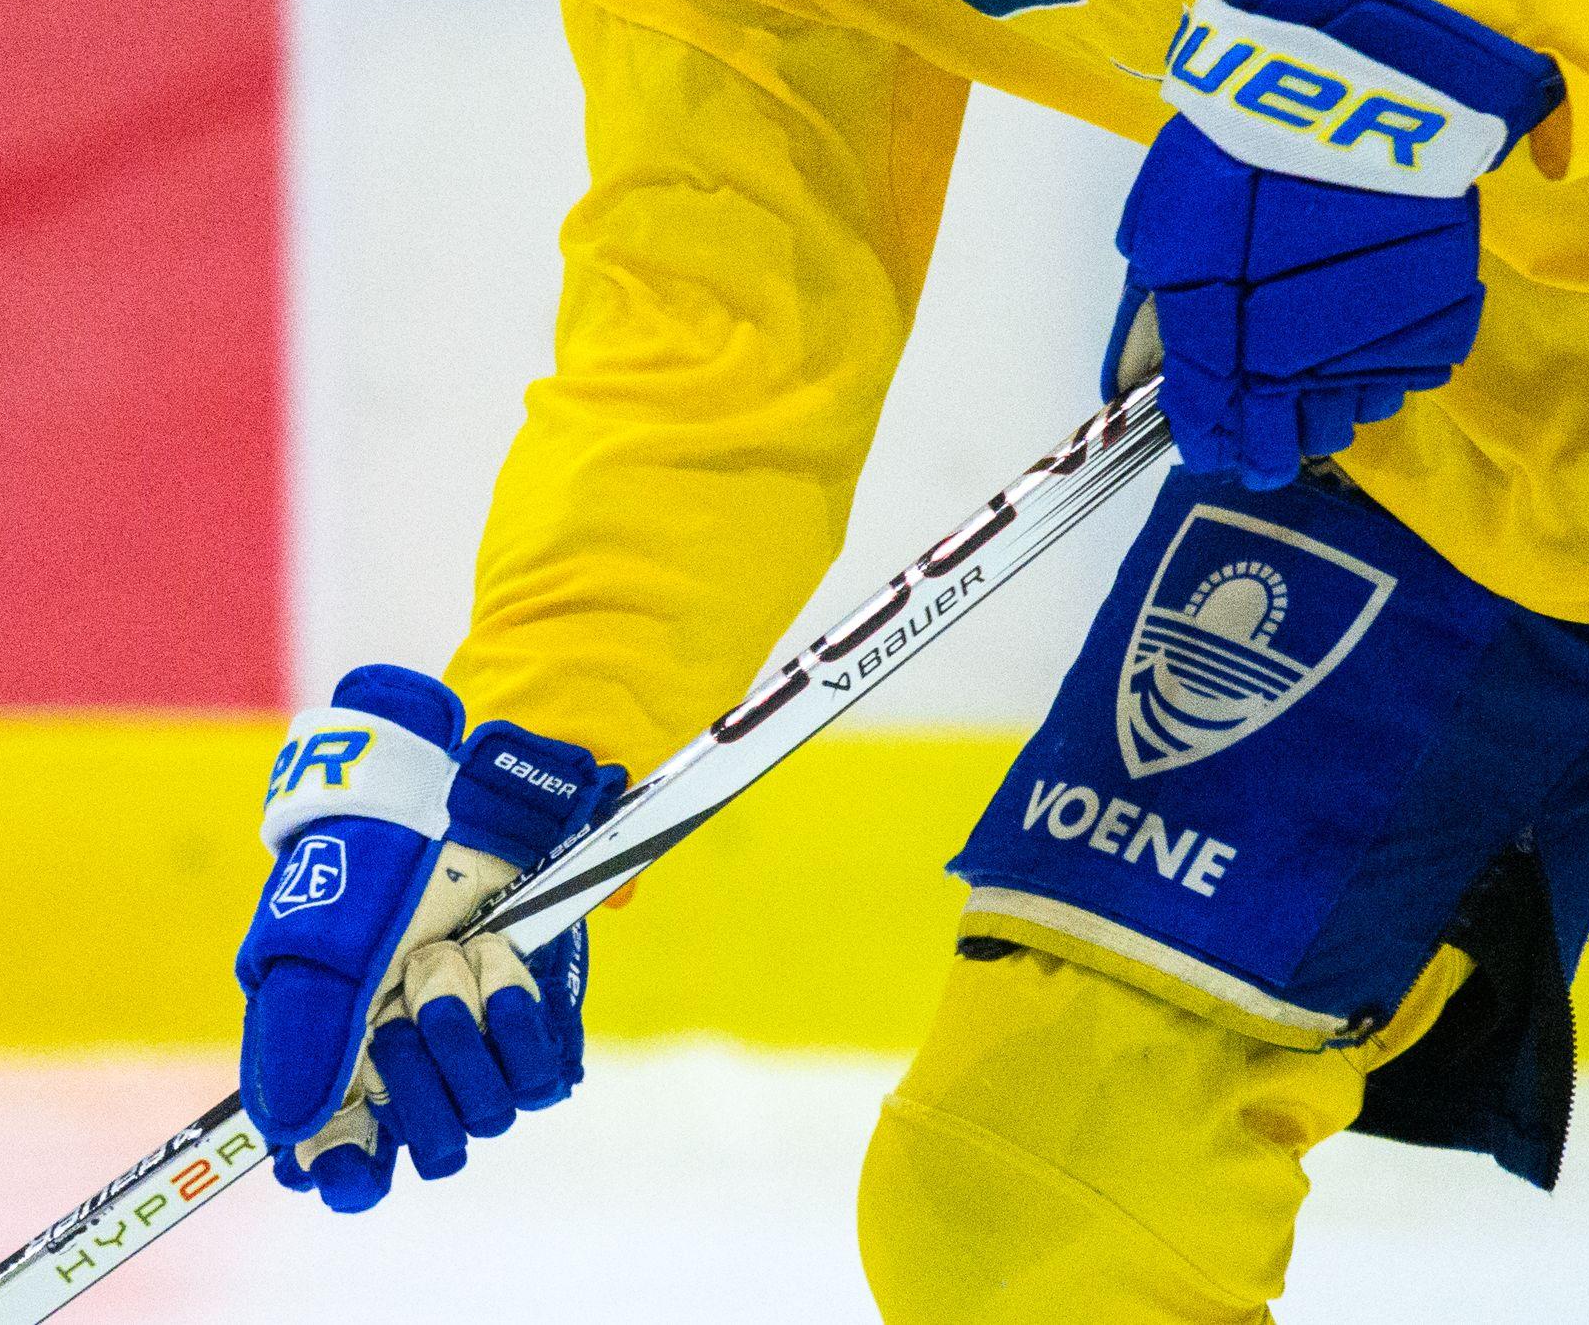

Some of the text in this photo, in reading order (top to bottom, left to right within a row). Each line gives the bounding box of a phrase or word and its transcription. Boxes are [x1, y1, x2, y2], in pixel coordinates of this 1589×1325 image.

[857, 564, 988, 680] BAUER
[493, 751, 578, 801] BAUER
[1021, 779, 1238, 897] VOENE
